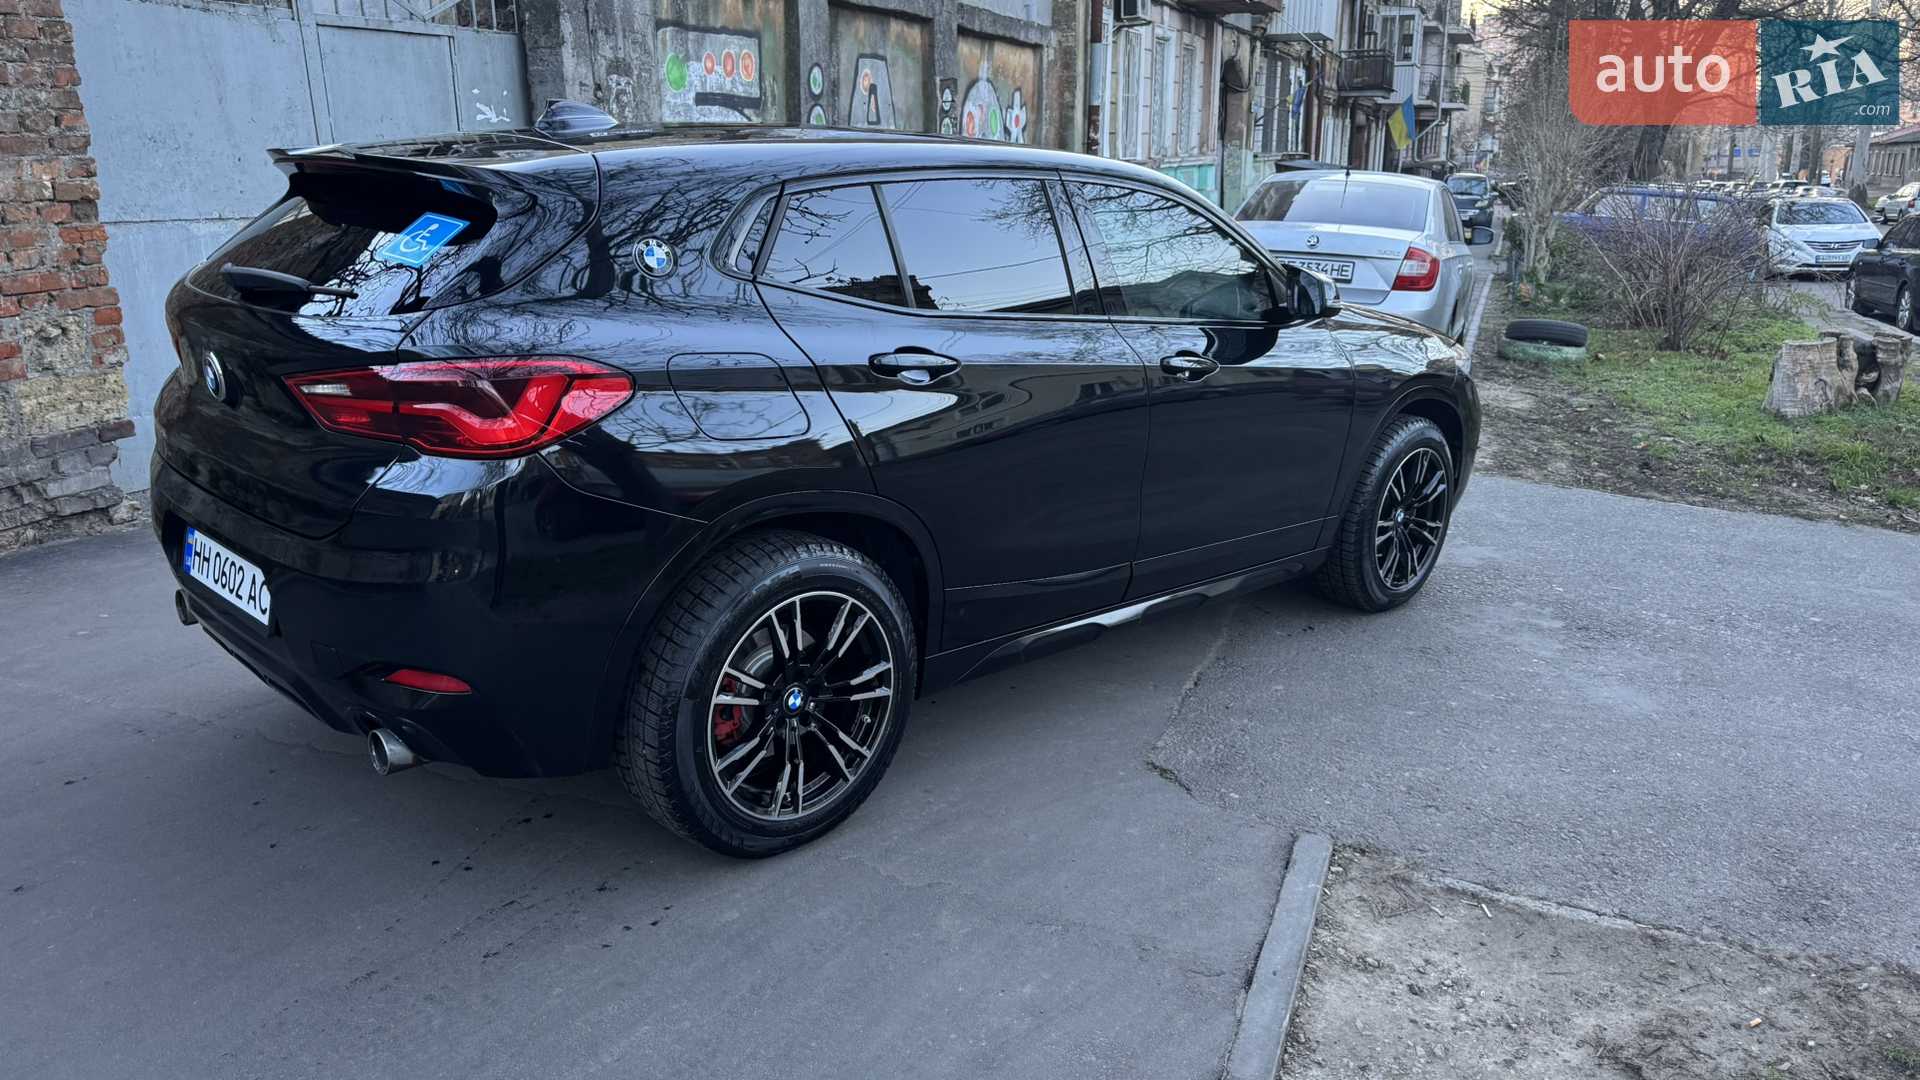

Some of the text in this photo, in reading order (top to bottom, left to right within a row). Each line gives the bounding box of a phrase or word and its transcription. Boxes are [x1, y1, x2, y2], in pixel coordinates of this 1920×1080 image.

[638, 239, 670, 252] BMW
[1329, 263, 1351, 278] HE
[192, 537, 268, 615] HH 0602 AC
